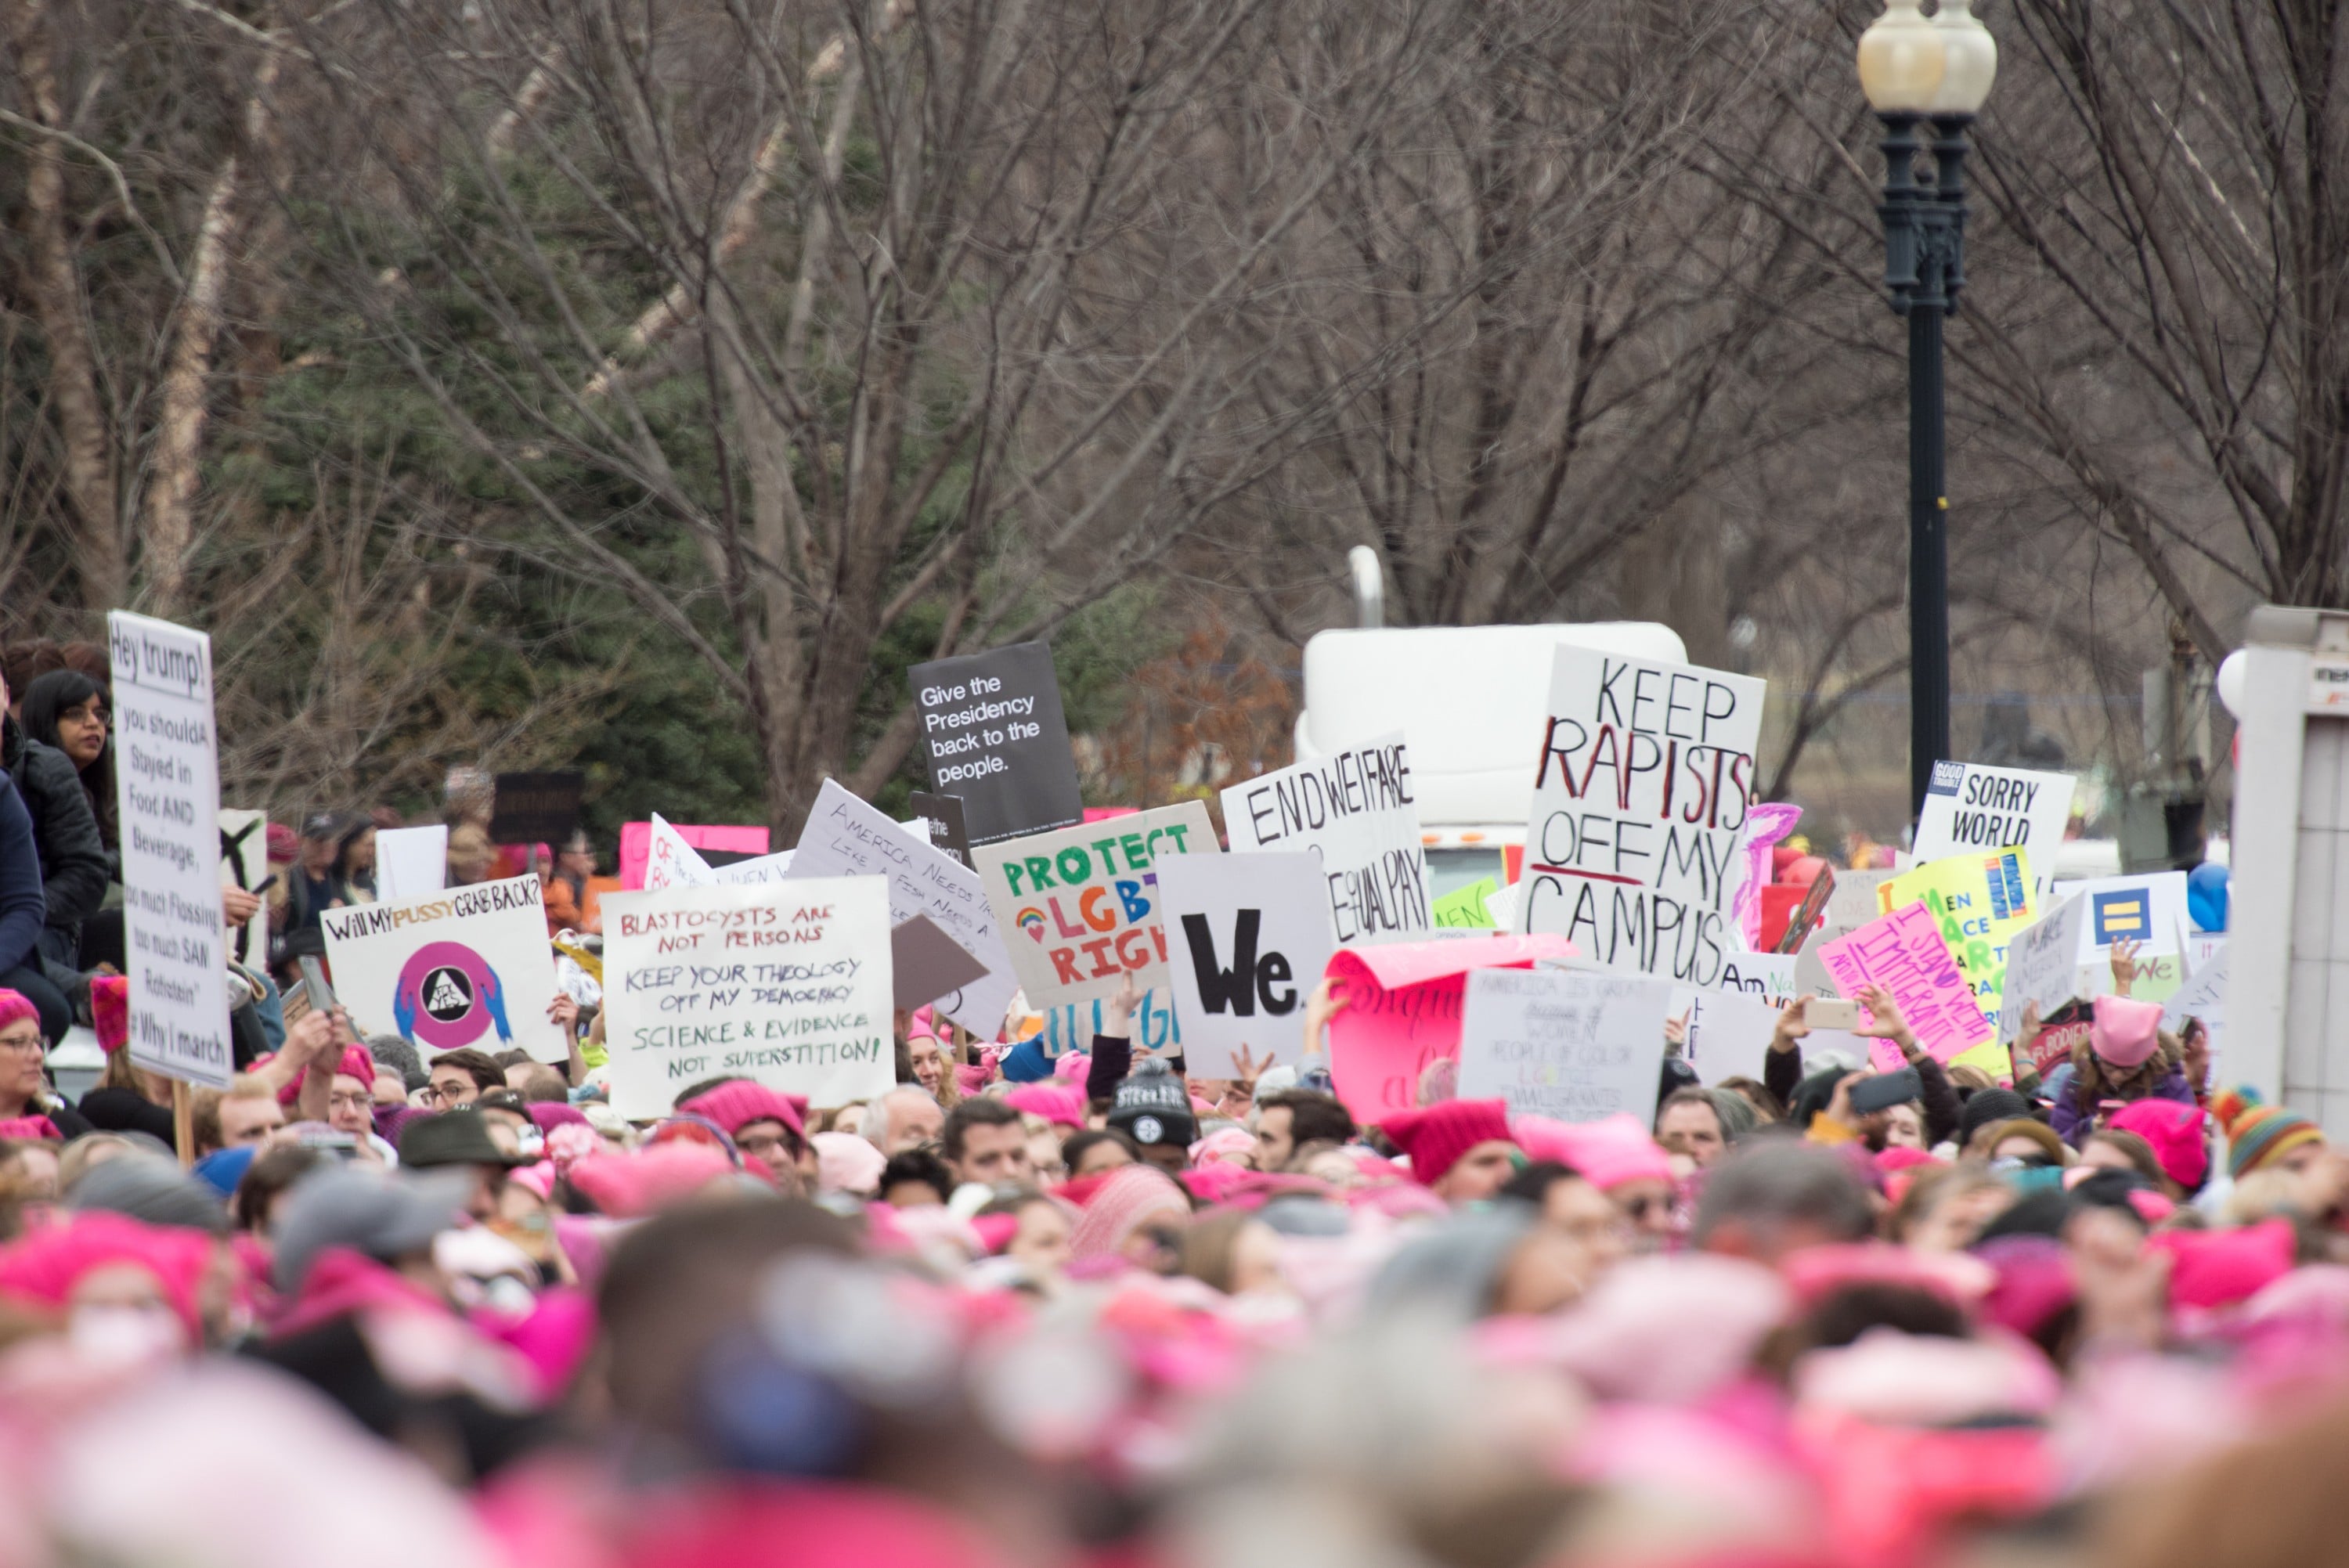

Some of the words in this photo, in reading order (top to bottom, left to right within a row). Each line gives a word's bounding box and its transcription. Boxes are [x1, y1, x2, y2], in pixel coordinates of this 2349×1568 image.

[110, 620, 139, 683] Hey
[143, 635, 205, 699] trump!
[921, 684, 966, 706] Give
[970, 676, 1001, 696] the
[1597, 658, 1735, 743] KEEP
[925, 696, 1034, 734] Presidency
[931, 733, 980, 757] back
[983, 730, 1004, 746] to
[1008, 722, 1041, 741] the
[131, 744, 174, 781] Stayed
[178, 759, 193, 783] in
[937, 755, 1009, 787] people.
[1535, 716, 1752, 831] RAPISTS
[1935, 762, 1964, 779] GOOD
[163, 796, 194, 827] AND
[1247, 773, 1326, 846] END
[1965, 773, 2040, 813] SORRY
[132, 826, 200, 874] Beverage,
[1952, 811, 2031, 848] WORLD
[830, 802, 912, 870] AMERICA
[922, 863, 973, 903] NEEDS
[831, 837, 868, 868] LIKE
[895, 874, 926, 899] FISH
[1003, 824, 1189, 897] PROTECT
[1542, 811, 1653, 873] OFF
[1656, 825, 1737, 911] MY
[369, 906, 393, 935] MY
[393, 900, 456, 929] PUSSY
[454, 889, 492, 917] GRAB
[492, 879, 539, 911] BACK?
[1383, 847, 1428, 932] PAY
[141, 887, 165, 915] much
[168, 891, 219, 936] Flossing
[621, 907, 777, 938] BLASTOCYSTS
[792, 904, 835, 924] ARE
[1527, 875, 1723, 987] CAMPUS
[1896, 903, 1929, 928] I
[152, 933, 180, 961] much
[182, 939, 210, 970] SAN
[658, 933, 705, 954] NOT
[725, 925, 824, 950] PERSONS
[626, 965, 684, 993] KEEP
[691, 964, 749, 989] YOUR
[753, 957, 862, 984] THEOLOGY
[1182, 908, 1297, 1017] We
[1722, 962, 1765, 993] Am
[1911, 932, 1959, 989] STAND
[432, 992, 460, 1011] YES
[660, 993, 701, 1013] OFF
[709, 989, 741, 1010] MY
[752, 986, 855, 1006] DEMOCRACY
[1946, 991, 1989, 1040] WITH
[140, 1010, 166, 1056] Why
[168, 1021, 175, 1053] I
[177, 1029, 226, 1065] march
[632, 1022, 735, 1051] SCIENCE
[743, 1020, 755, 1039] &
[764, 1013, 869, 1040] EVIDENCE
[668, 1057, 708, 1080] NOT
[723, 1037, 881, 1069] SUPERSTITION!
